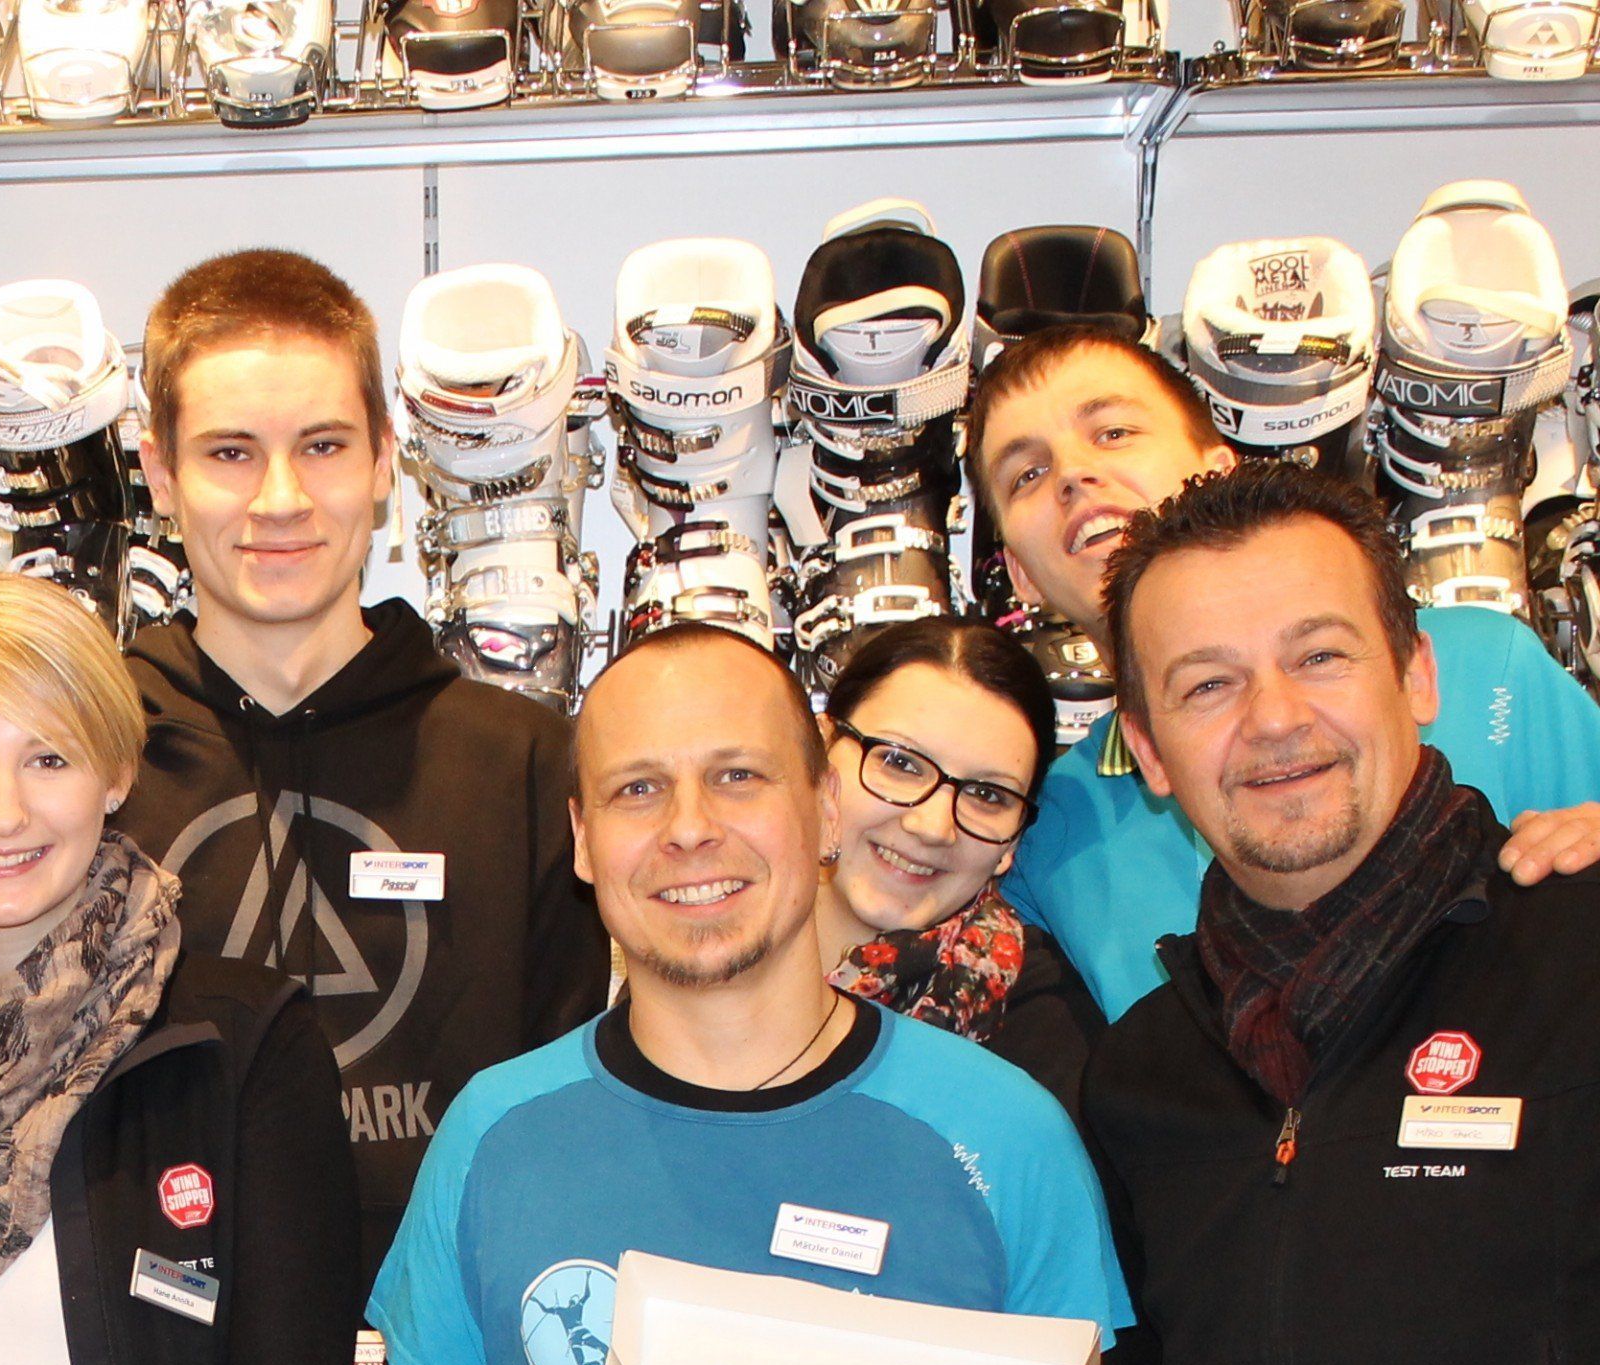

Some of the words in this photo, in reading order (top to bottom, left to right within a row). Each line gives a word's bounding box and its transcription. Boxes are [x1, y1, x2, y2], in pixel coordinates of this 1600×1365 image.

[629, 381, 743, 407] salomon
[1381, 373, 1492, 407] ATOMIC
[789, 386, 890, 418] ATOMIC
[1263, 401, 1351, 431] salomon
[374, 861, 429, 869] INTERSPORT
[381, 878, 418, 891] Pascal
[1429, 1041, 1463, 1059] WIND
[1415, 1057, 1467, 1076] STOPPER
[1433, 1105, 1501, 1114] INTERSPORT
[1383, 1165, 1419, 1178] TEST
[1422, 1165, 1466, 1177] TEAM
[170, 1172, 201, 1192] WIND
[166, 1188, 211, 1211] STOPPER
[804, 1217, 868, 1236] INTERSPORT
[831, 1246, 863, 1260] Daniel
[157, 1265, 207, 1290] INTERSPORT
